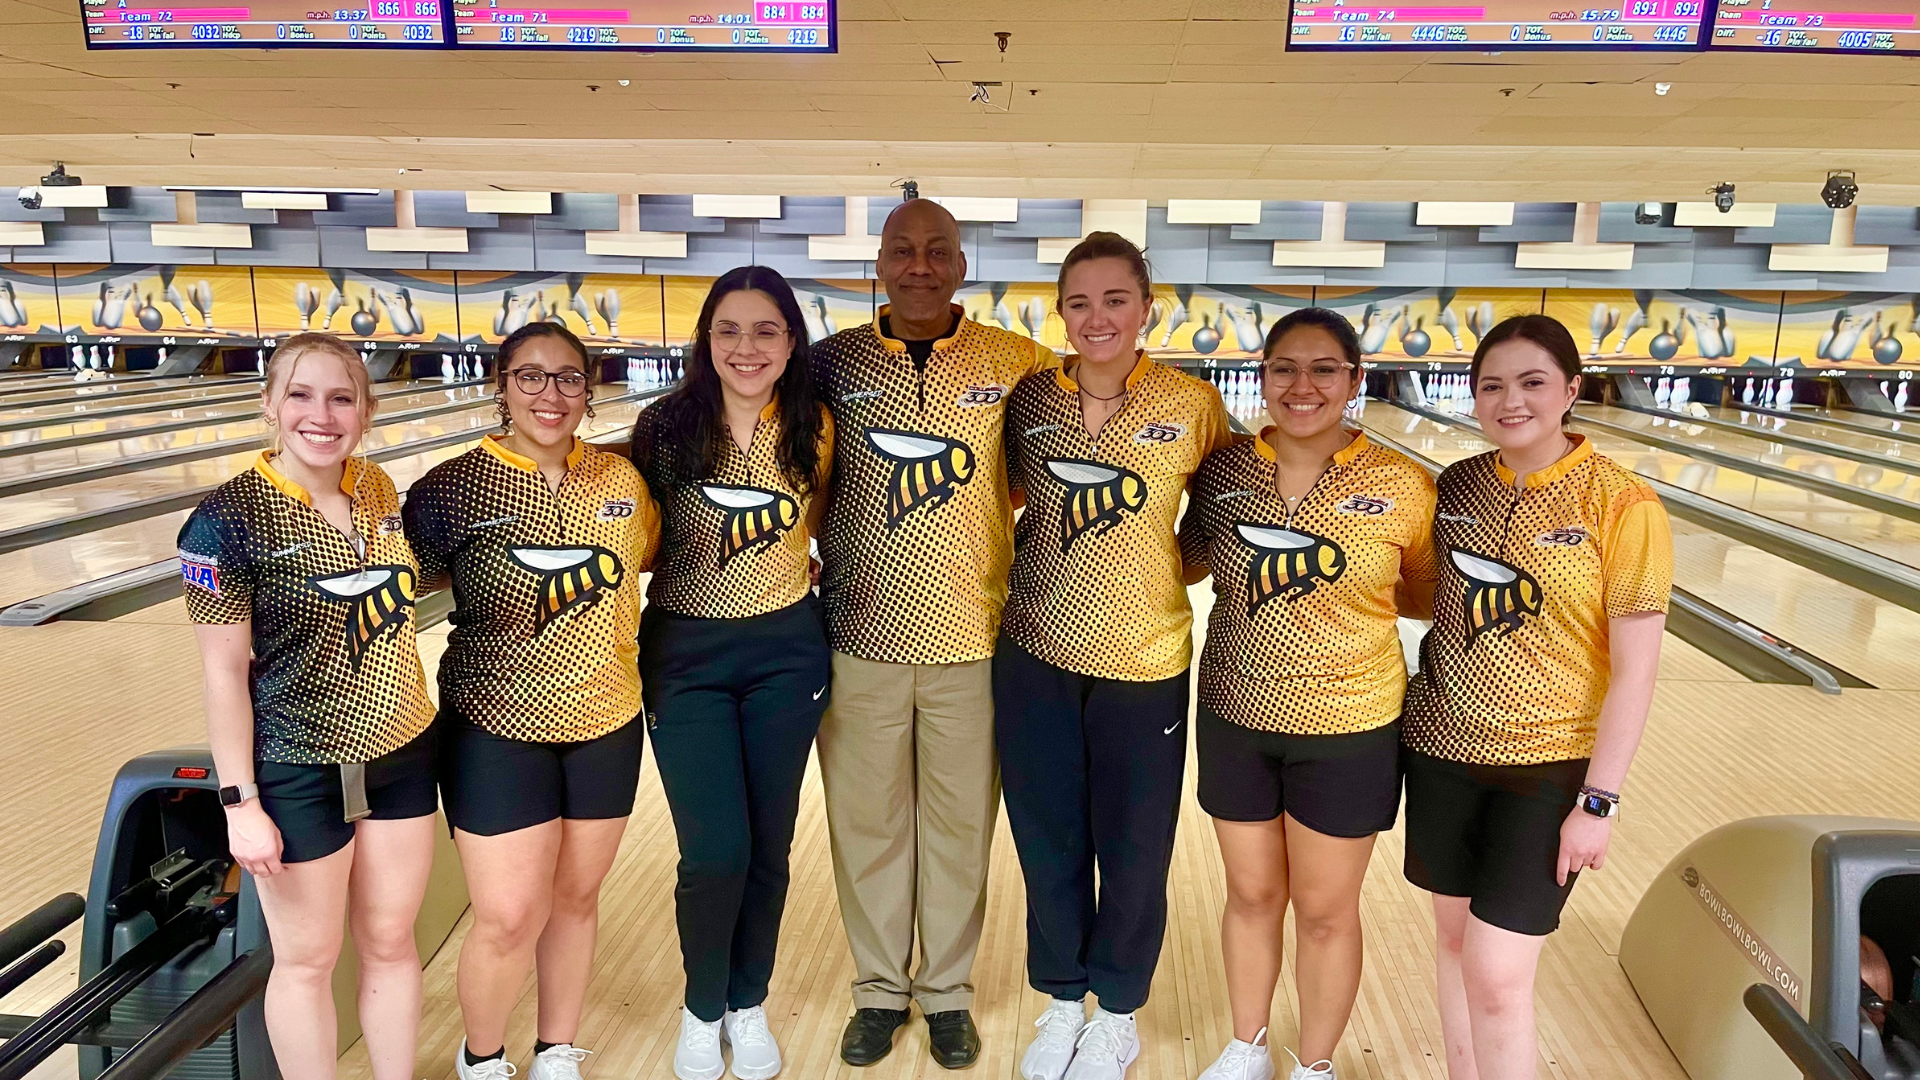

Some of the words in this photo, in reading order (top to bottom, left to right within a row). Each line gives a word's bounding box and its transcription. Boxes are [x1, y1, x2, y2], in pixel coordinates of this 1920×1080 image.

[118, 0, 127, 8] A
[378, 2, 399, 15] 866
[414, 2, 437, 16] 866
[1633, 2, 1658, 15] 891
[1674, 2, 1699, 15] 891
[120, 12, 151, 21] Team
[158, 12, 172, 20] 72
[307, 11, 331, 19] m.p.h.
[334, 10, 368, 20] 13.37
[491, 12, 524, 22] Team
[532, 13, 547, 22] 71
[689, 15, 714, 24] m.p.h.
[717, 14, 751, 24] 14.01
[763, 6, 786, 19] 884
[801, 6, 824, 19] 884
[1333, 11, 1369, 21] Team
[1377, 11, 1395, 20] 74
[1550, 12, 1577, 20] m.p.h.
[1580, 10, 1619, 20] 15.79
[1760, 14, 1797, 24] Team
[1804, 16, 1823, 26] 73
[122, 26, 143, 39] -18
[191, 25, 220, 39] 4032
[277, 25, 285, 38] 0
[350, 25, 358, 39] 0
[403, 26, 433, 39] 4032
[500, 27, 515, 41] 18
[567, 28, 596, 42] 4219
[657, 28, 665, 42] 0
[732, 29, 740, 43] 0
[788, 29, 817, 44] 4219
[1338, 26, 1355, 41] 16
[1411, 26, 1444, 40] 4446
[1510, 26, 1520, 40] 0
[1593, 26, 1602, 40] 0
[1654, 26, 1687, 40] 4446
[1756, 30, 1781, 44] -16
[1802, 38, 1818, 46] fall
[1838, 32, 1872, 47] 4005
[66, 335, 78, 343] 63
[163, 337, 176, 345] 64
[264, 339, 276, 347] 65
[364, 342, 377, 350] 66
[465, 344, 478, 352] 67
[670, 348, 683, 357] 69
[1204, 359, 1217, 368] 74
[1428, 362, 1442, 371] 76
[1660, 366, 1674, 374] 78
[1780, 368, 1794, 377] 79
[1898, 371, 1913, 379] 80
[965, 390, 1001, 404] 300
[1140, 427, 1177, 442] 300
[603, 506, 632, 518] 300
[1343, 500, 1384, 515] 300
[182, 562, 216, 592] AIA
[1699, 883, 1799, 1001] BOWLBOWLBOWL.COM
